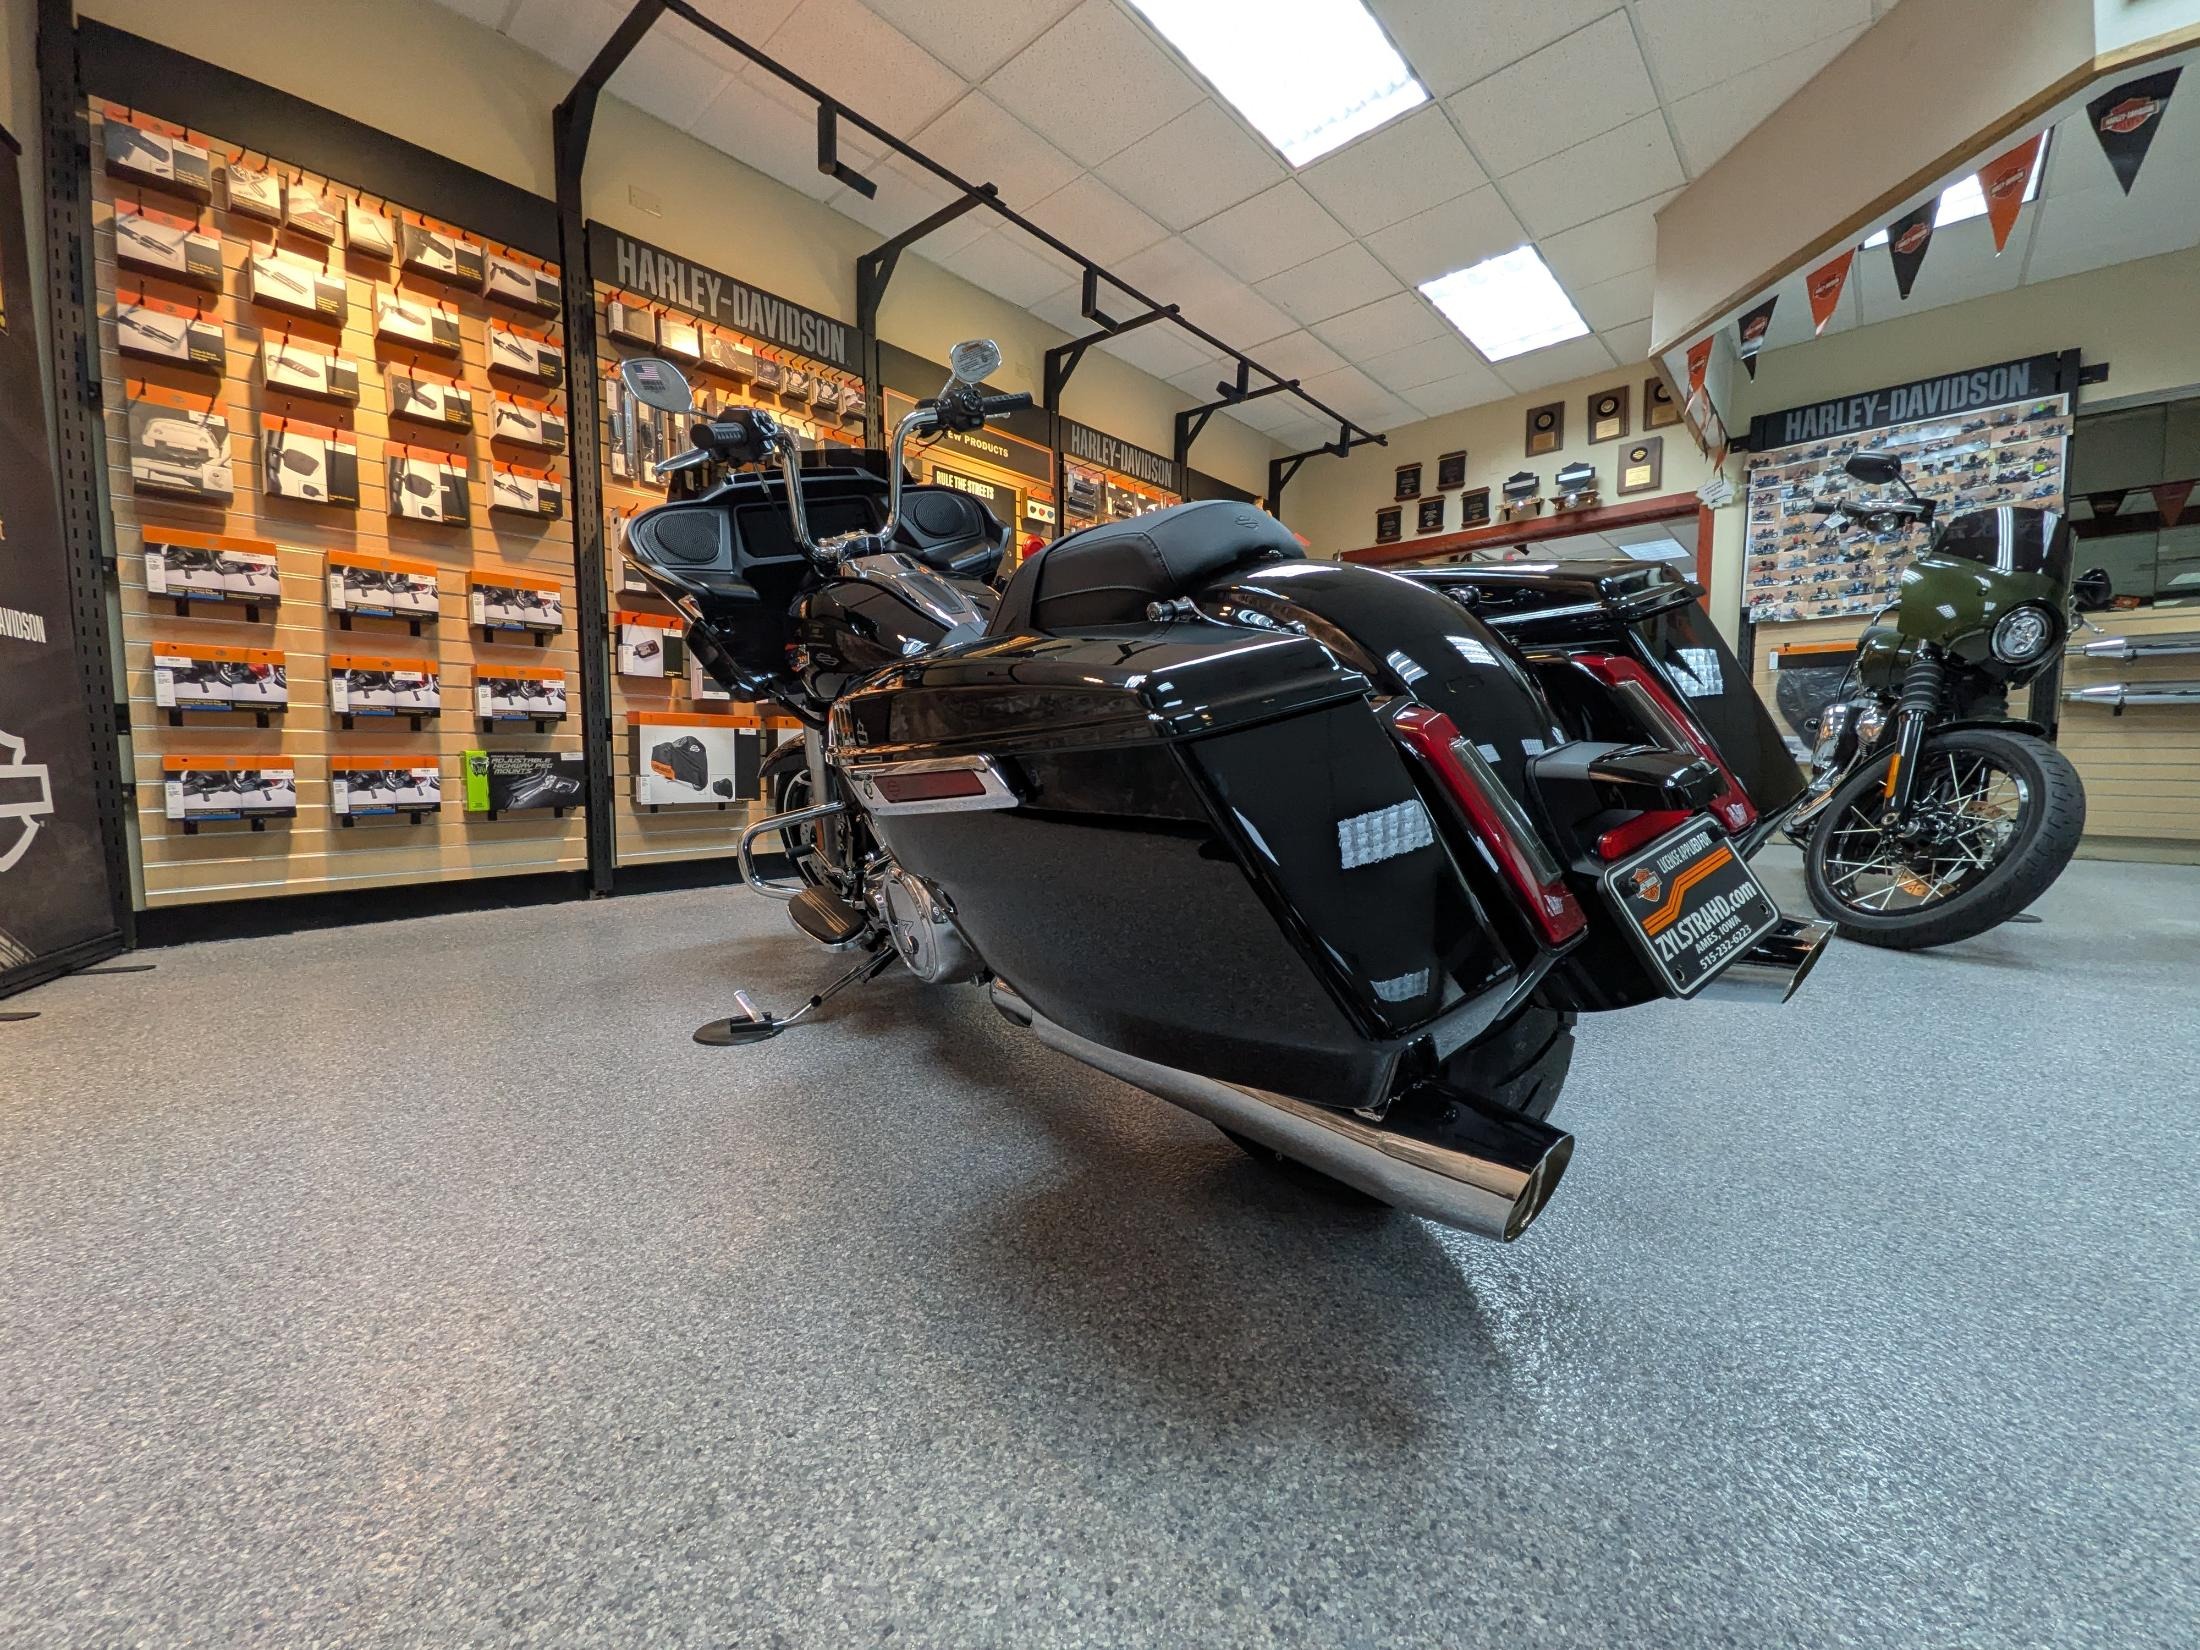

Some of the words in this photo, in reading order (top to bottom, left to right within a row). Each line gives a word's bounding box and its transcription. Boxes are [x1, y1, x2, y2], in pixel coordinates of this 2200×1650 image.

[616, 237, 845, 365] HARLEY-DAVIDSON
[1784, 362, 2031, 443] HARLEY-DAVIDSON
[947, 430, 962, 442] EW
[964, 434, 1009, 458] PRODUCTS
[1071, 424, 1172, 489] HARLEY-DAVIDSON
[936, 470, 954, 488] RULE
[954, 475, 968, 492] THE
[967, 479, 995, 500] STREETS
[1656, 849, 1680, 874] LICENSE
[1677, 837, 1703, 863] APPLIED
[1696, 831, 1713, 849] FOR
[1654, 881, 1758, 962] ZYLSTRAHD.com
[1694, 930, 1721, 955] AMES,
[1718, 914, 1742, 936] IOWA
[1699, 924, 1752, 970] 515-232-6223
